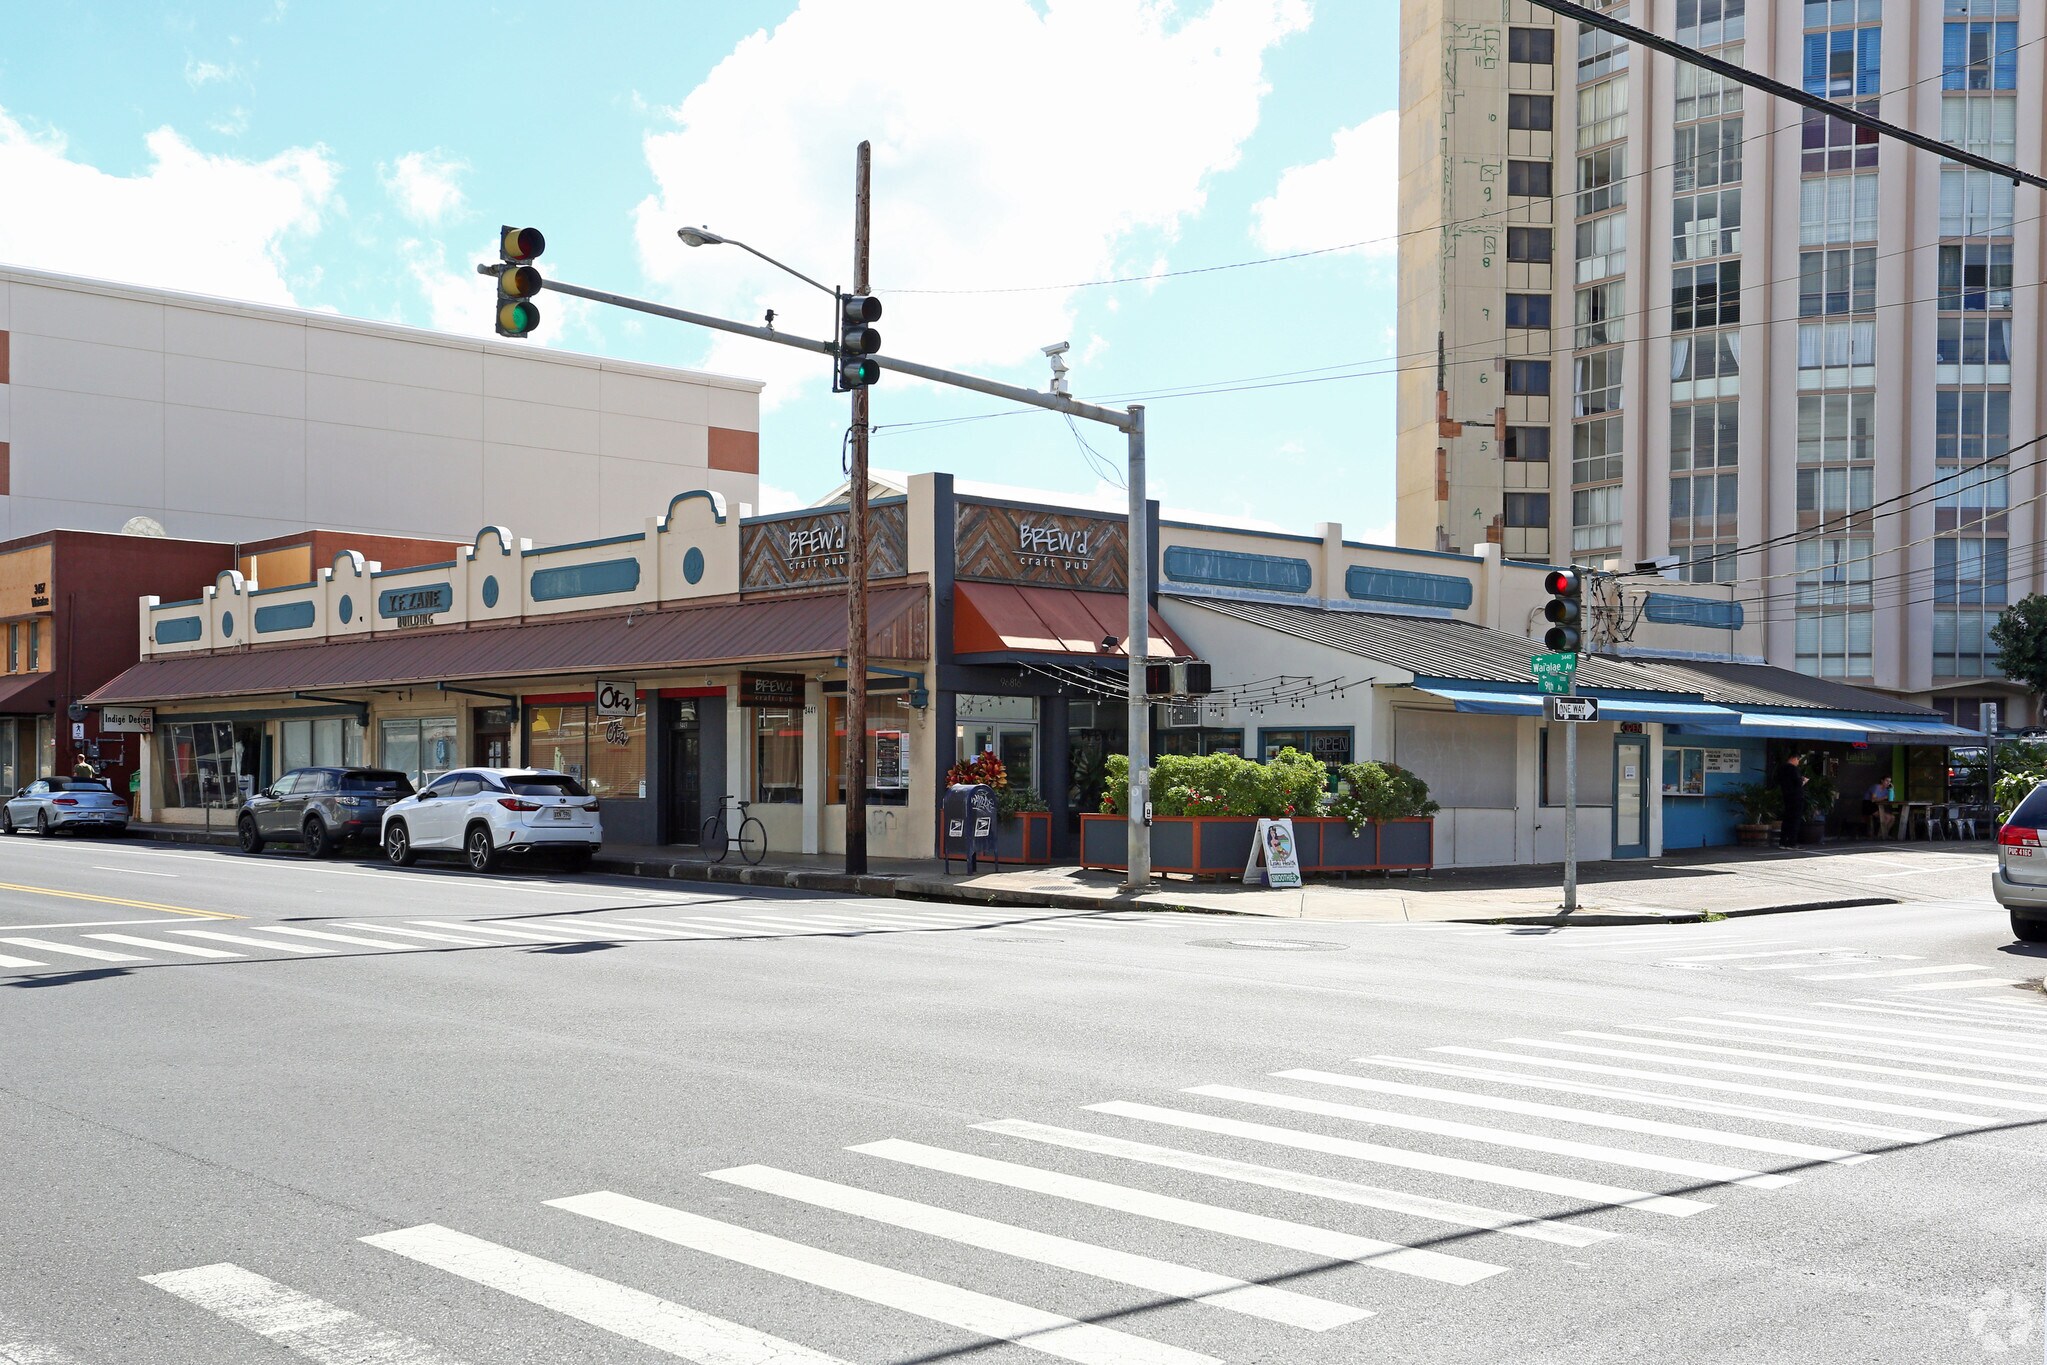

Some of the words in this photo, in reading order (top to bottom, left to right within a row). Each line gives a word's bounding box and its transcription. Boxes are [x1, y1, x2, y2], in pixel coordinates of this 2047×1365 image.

[1484, 187, 1492, 202] 9
[1482, 257, 1491, 268] 8
[1482, 308, 1490, 321] 7
[1480, 373, 1488, 384] 6
[1479, 441, 1488, 452] 5
[1473, 507, 1482, 520] 4
[789, 557, 817, 570] craft
[824, 554, 844, 568] pub
[1020, 556, 1055, 568] craft
[1065, 560, 1089, 571] pub
[409, 590, 442, 609] ZANE
[397, 613, 434, 628] BUILDING
[1565, 662, 1573, 670] Av
[1544, 681, 1554, 691] 9th
[1559, 704, 1571, 715] ONE
[1573, 704, 1585, 714] WAY
[128, 714, 151, 726] Design
[1622, 722, 1642, 733] OPEN
[1317, 736, 1347, 751] OPEN
[2008, 847, 2018, 855] PUC
[1271, 873, 1296, 882] SMOOTHIES
